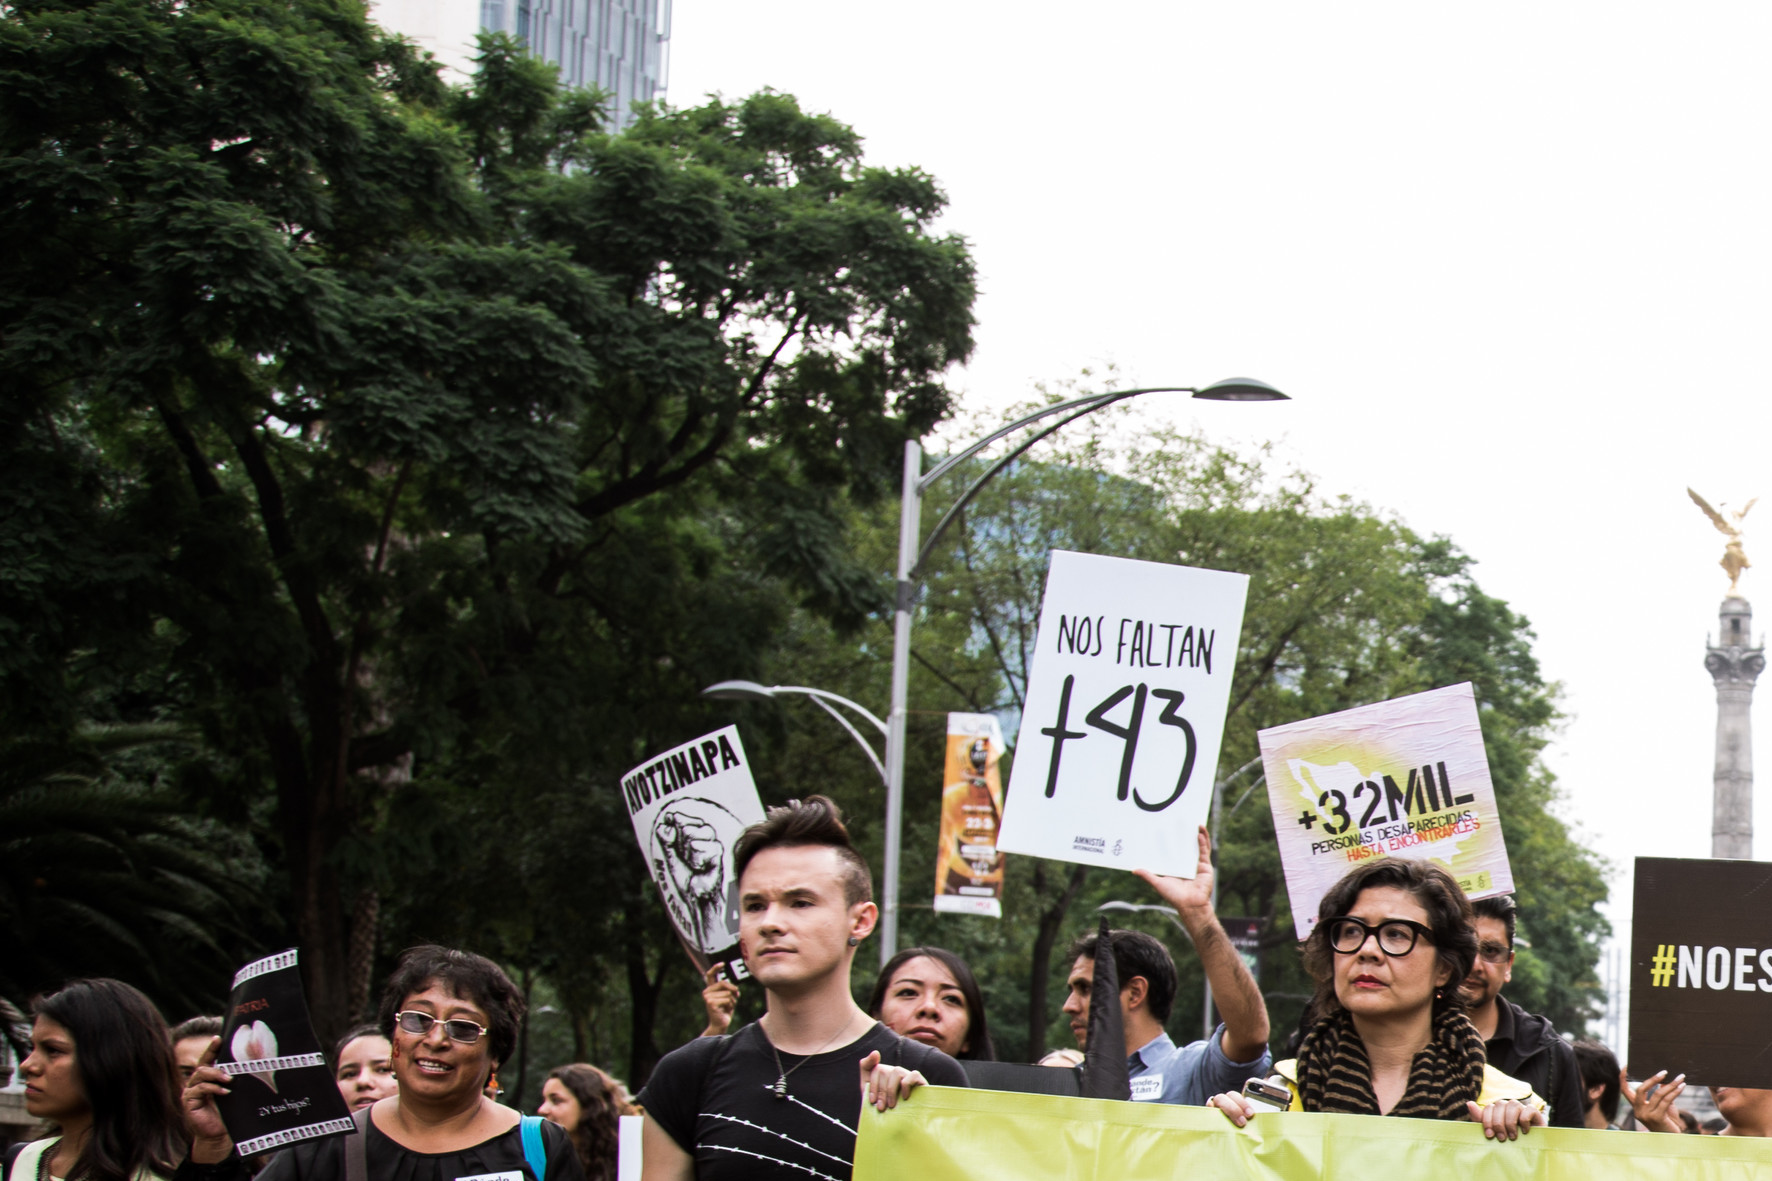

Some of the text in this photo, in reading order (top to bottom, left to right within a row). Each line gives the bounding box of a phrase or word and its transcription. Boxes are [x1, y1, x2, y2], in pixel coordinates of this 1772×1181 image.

[1057, 614, 1215, 675] NOS FALTAN
[1041, 673, 1197, 812] +43
[624, 734, 741, 816] AYOTZINAPA
[1311, 810, 1473, 855] PERSONAS DESAPARECIDAS
[1346, 818, 1481, 862] HASTA ENCONTRARLES
